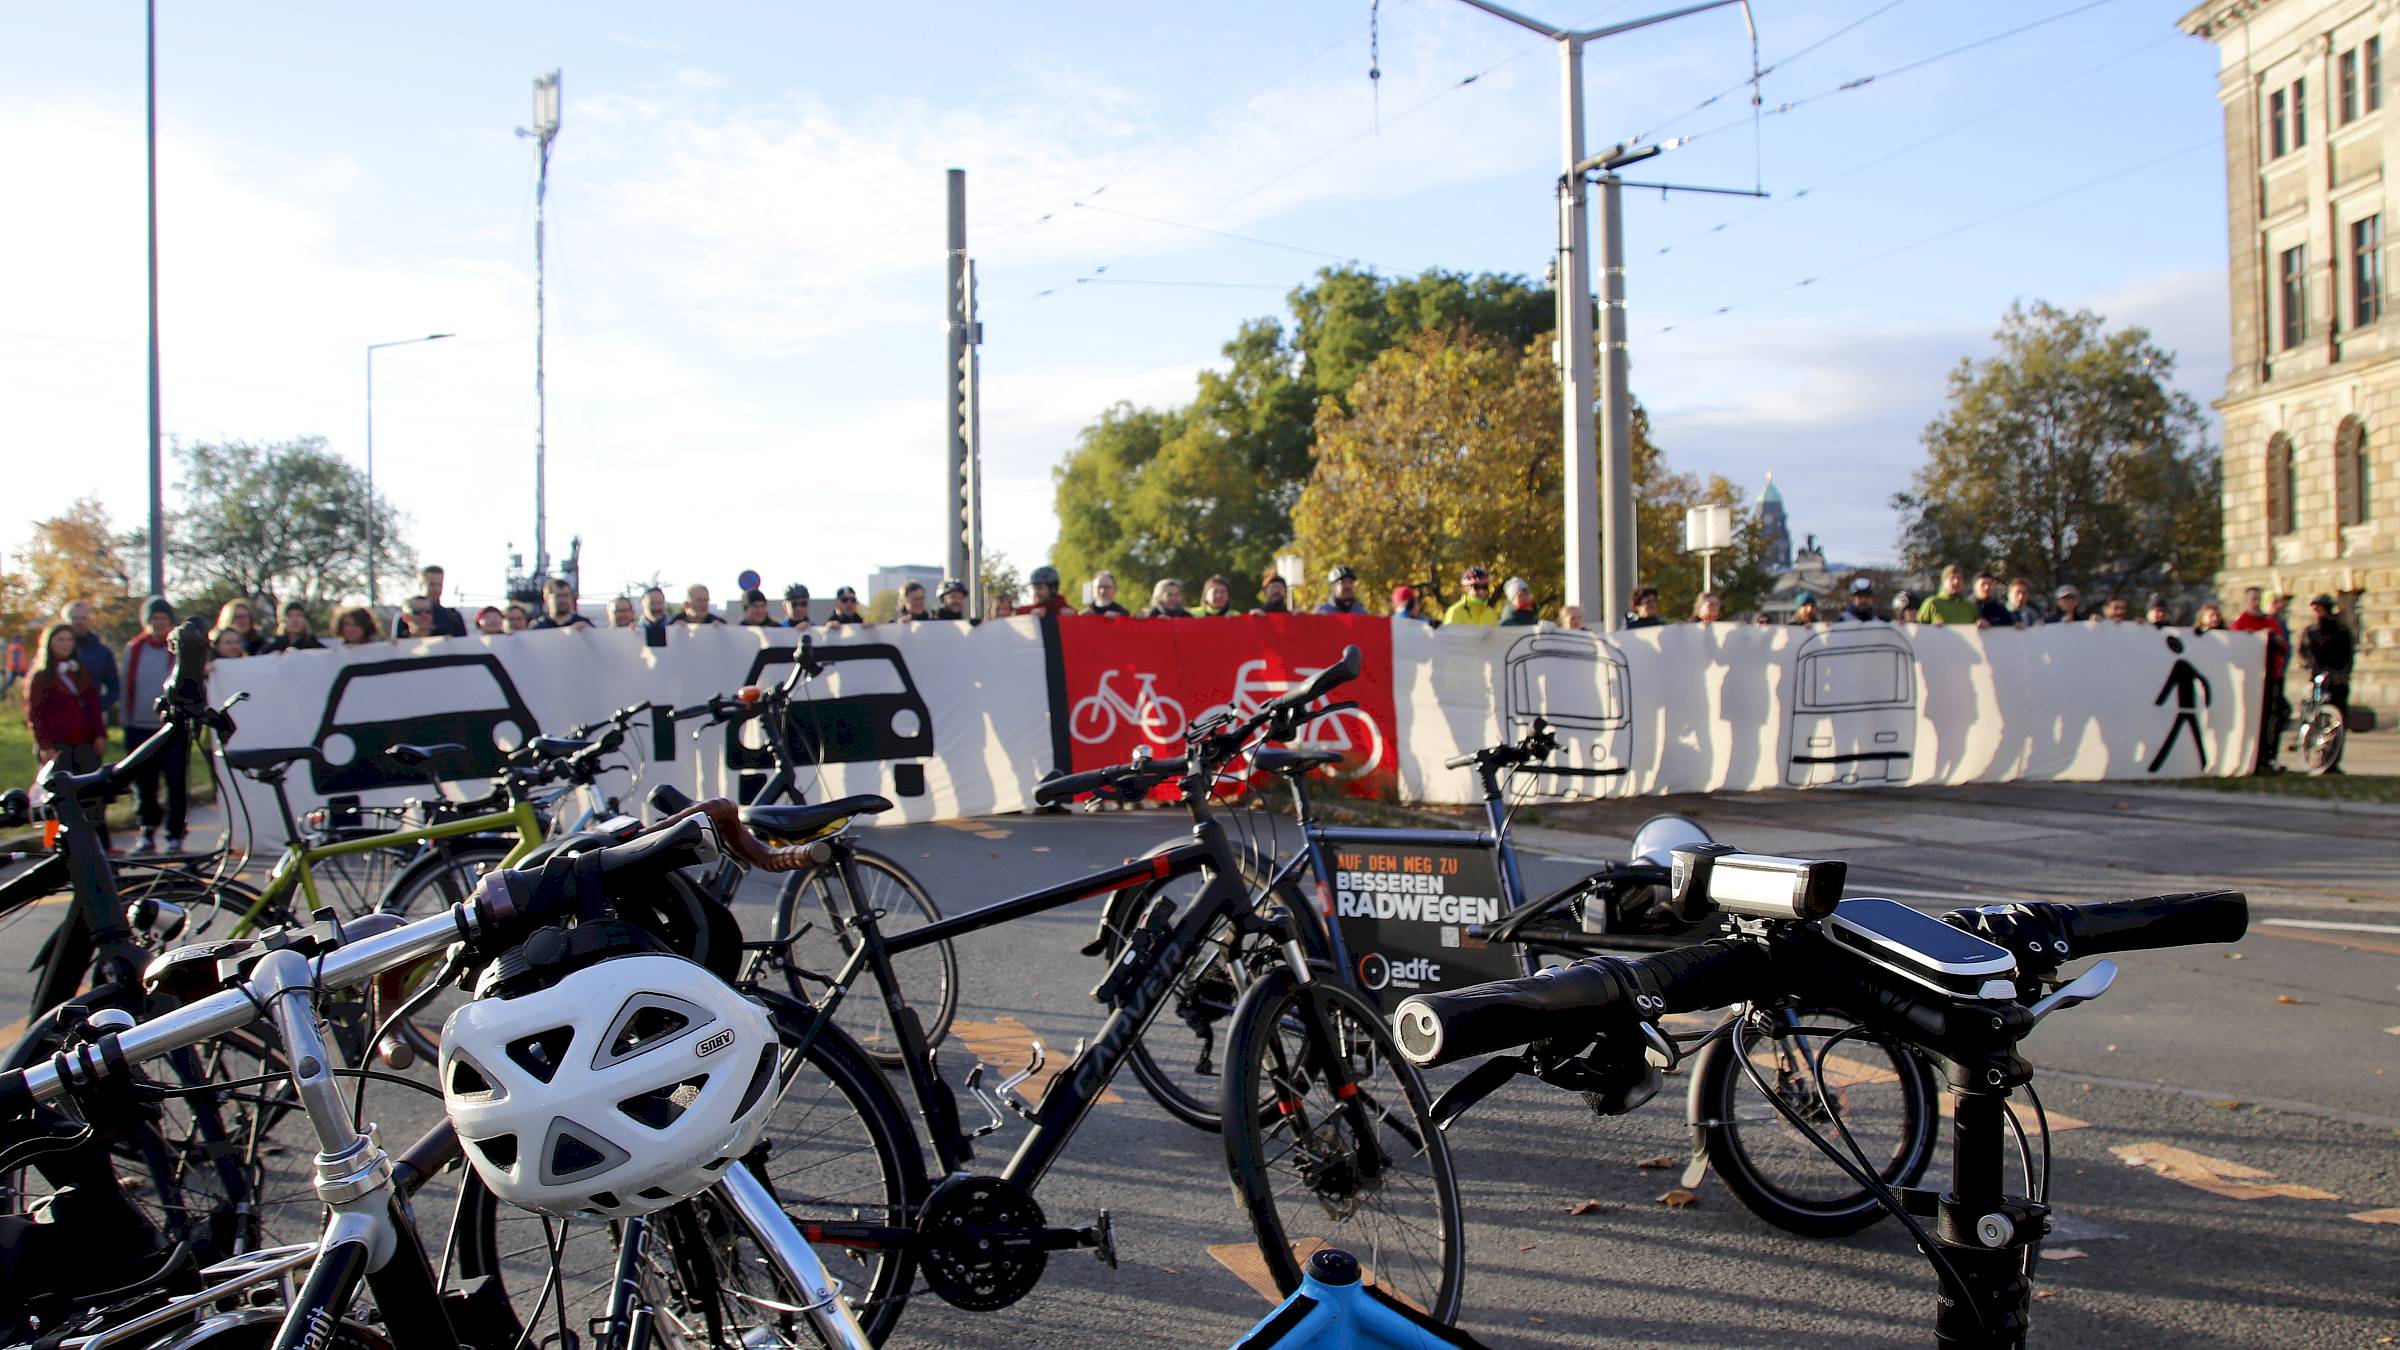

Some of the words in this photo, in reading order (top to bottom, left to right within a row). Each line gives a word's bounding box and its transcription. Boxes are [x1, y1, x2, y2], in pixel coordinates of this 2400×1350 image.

[1337, 852, 1362, 871] AUF
[1369, 854, 1396, 872] DEM
[1403, 856, 1432, 874] WEG
[1440, 857, 1458, 875] ZU
[1336, 872, 1444, 894] BESSEREN
[1337, 891, 1499, 924] RADWEGEN
[1391, 957, 1441, 982] adfc
[700, 1031, 730, 1054] ABUS
